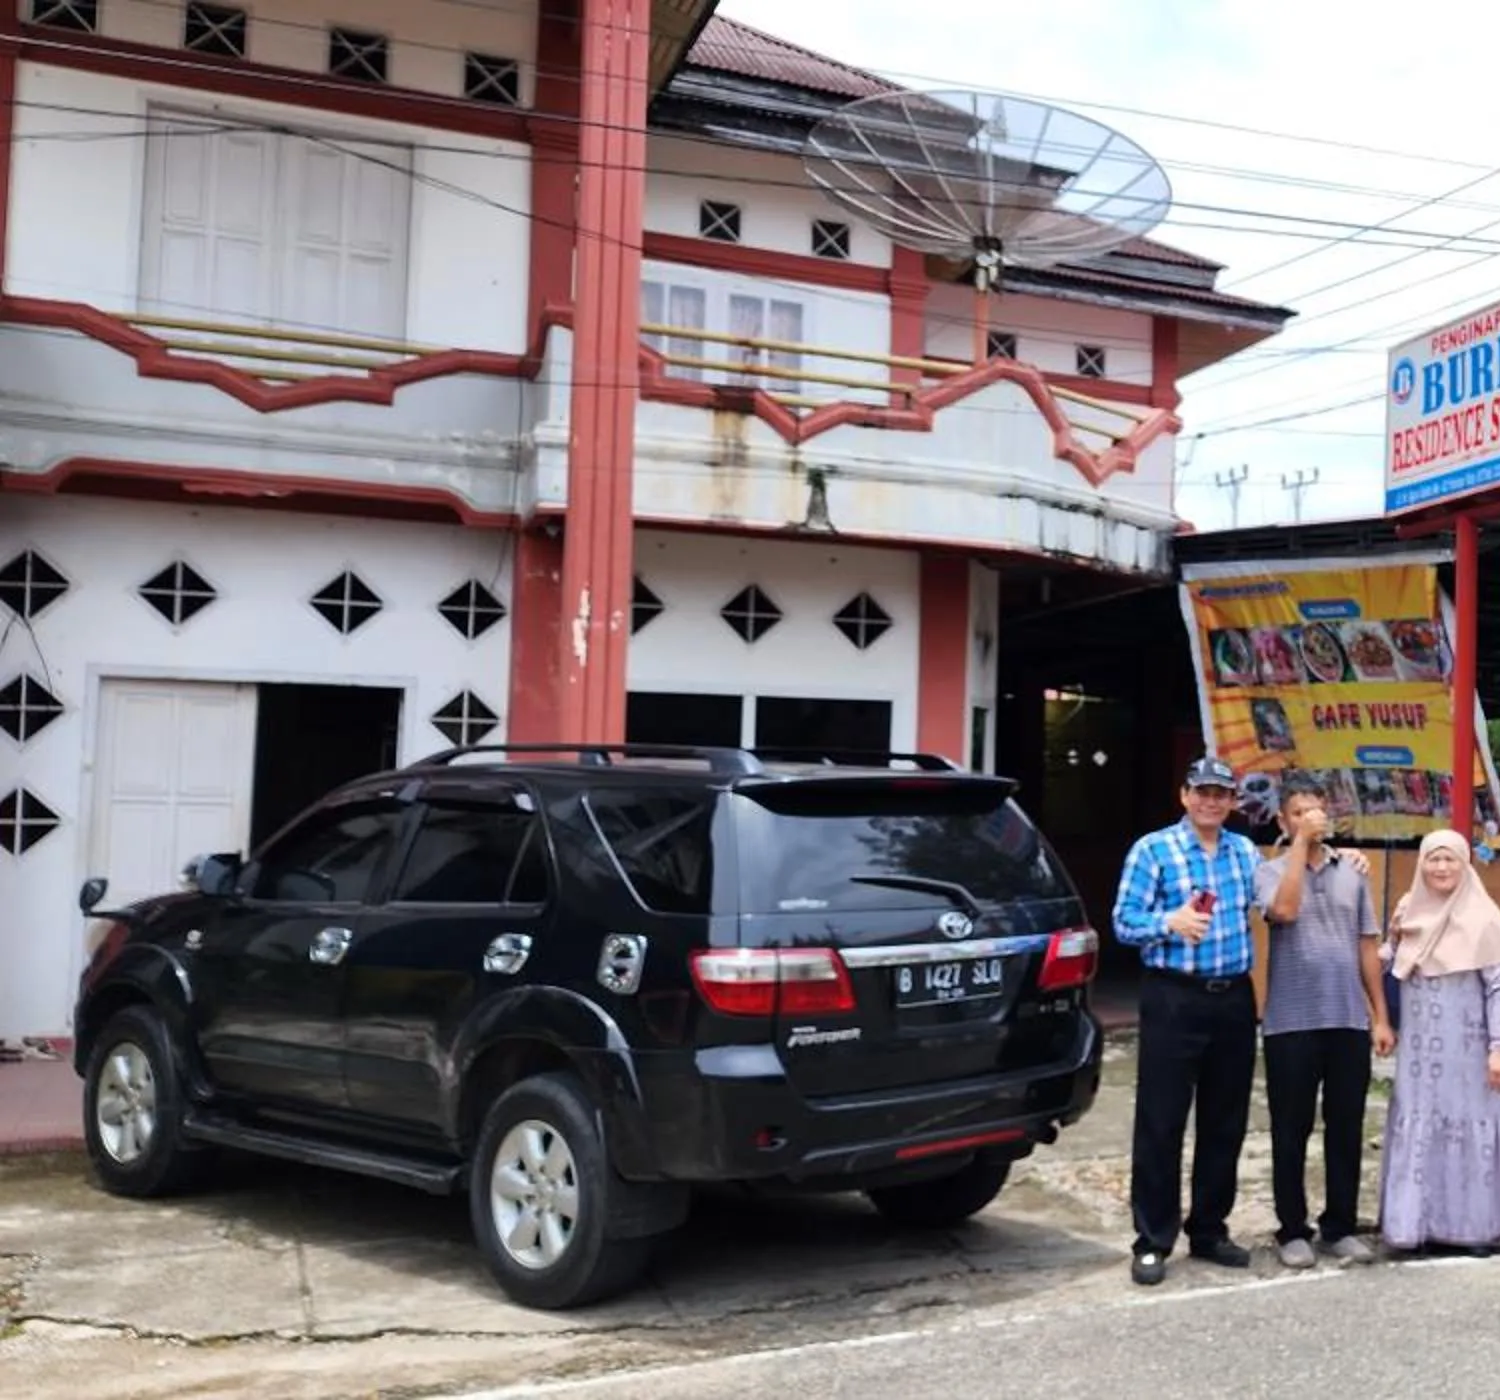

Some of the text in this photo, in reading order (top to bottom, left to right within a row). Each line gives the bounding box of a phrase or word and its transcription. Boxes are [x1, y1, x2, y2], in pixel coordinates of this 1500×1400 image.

[1393, 404, 1485, 471] RESIDENCE
[1312, 703, 1427, 732] CAFE YUSUF
[899, 967, 913, 993] B
[925, 963, 962, 990] 1427
